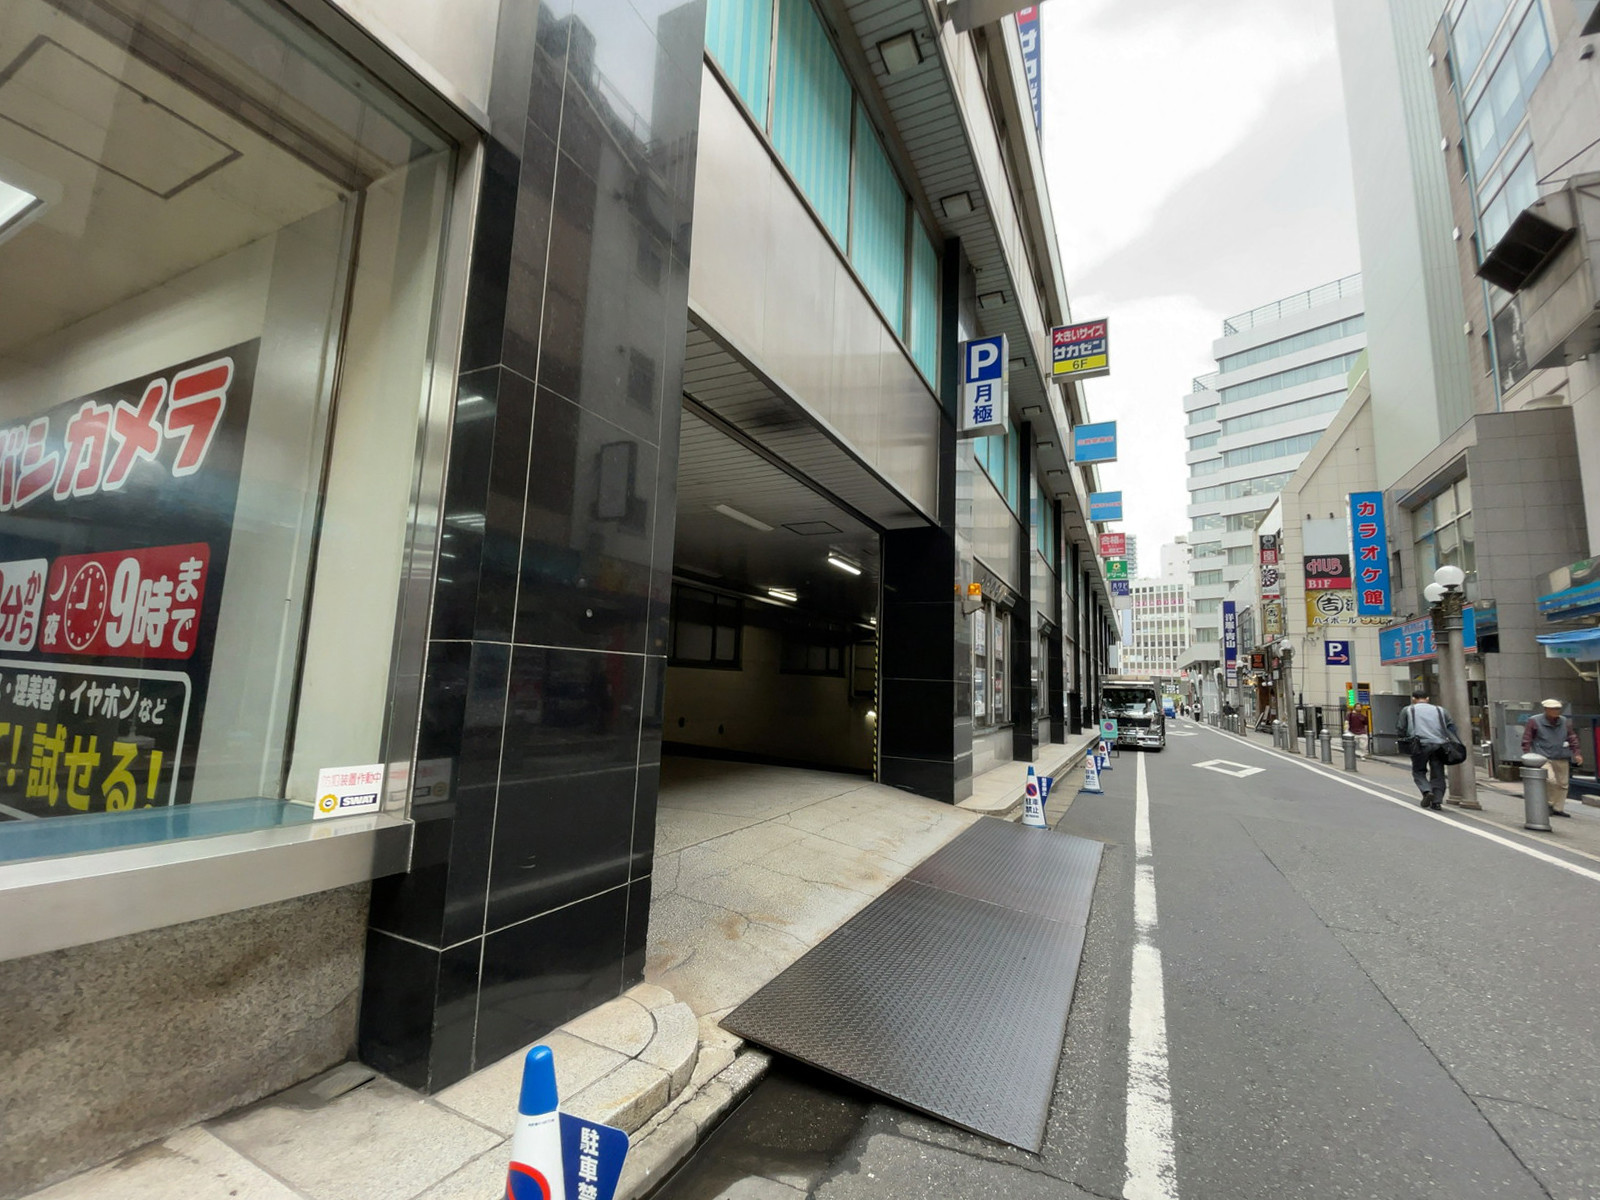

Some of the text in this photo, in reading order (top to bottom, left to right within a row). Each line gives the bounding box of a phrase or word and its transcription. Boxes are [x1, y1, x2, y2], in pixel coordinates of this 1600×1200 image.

[1055, 323, 1104, 344] 大きいサイズ
[1054, 339, 1106, 360] サカゼン
[970, 343, 998, 379] P
[1073, 358, 1088, 369] 6F
[973, 384, 992, 424] 月極
[1357, 501, 1384, 606] カラオケ館
[1306, 557, 1343, 575] HUB
[1308, 579, 1331, 588] B1F
[44, 613, 61, 645] 夜
[1328, 642, 1342, 657] P
[342, 795, 375, 806] SWAT
